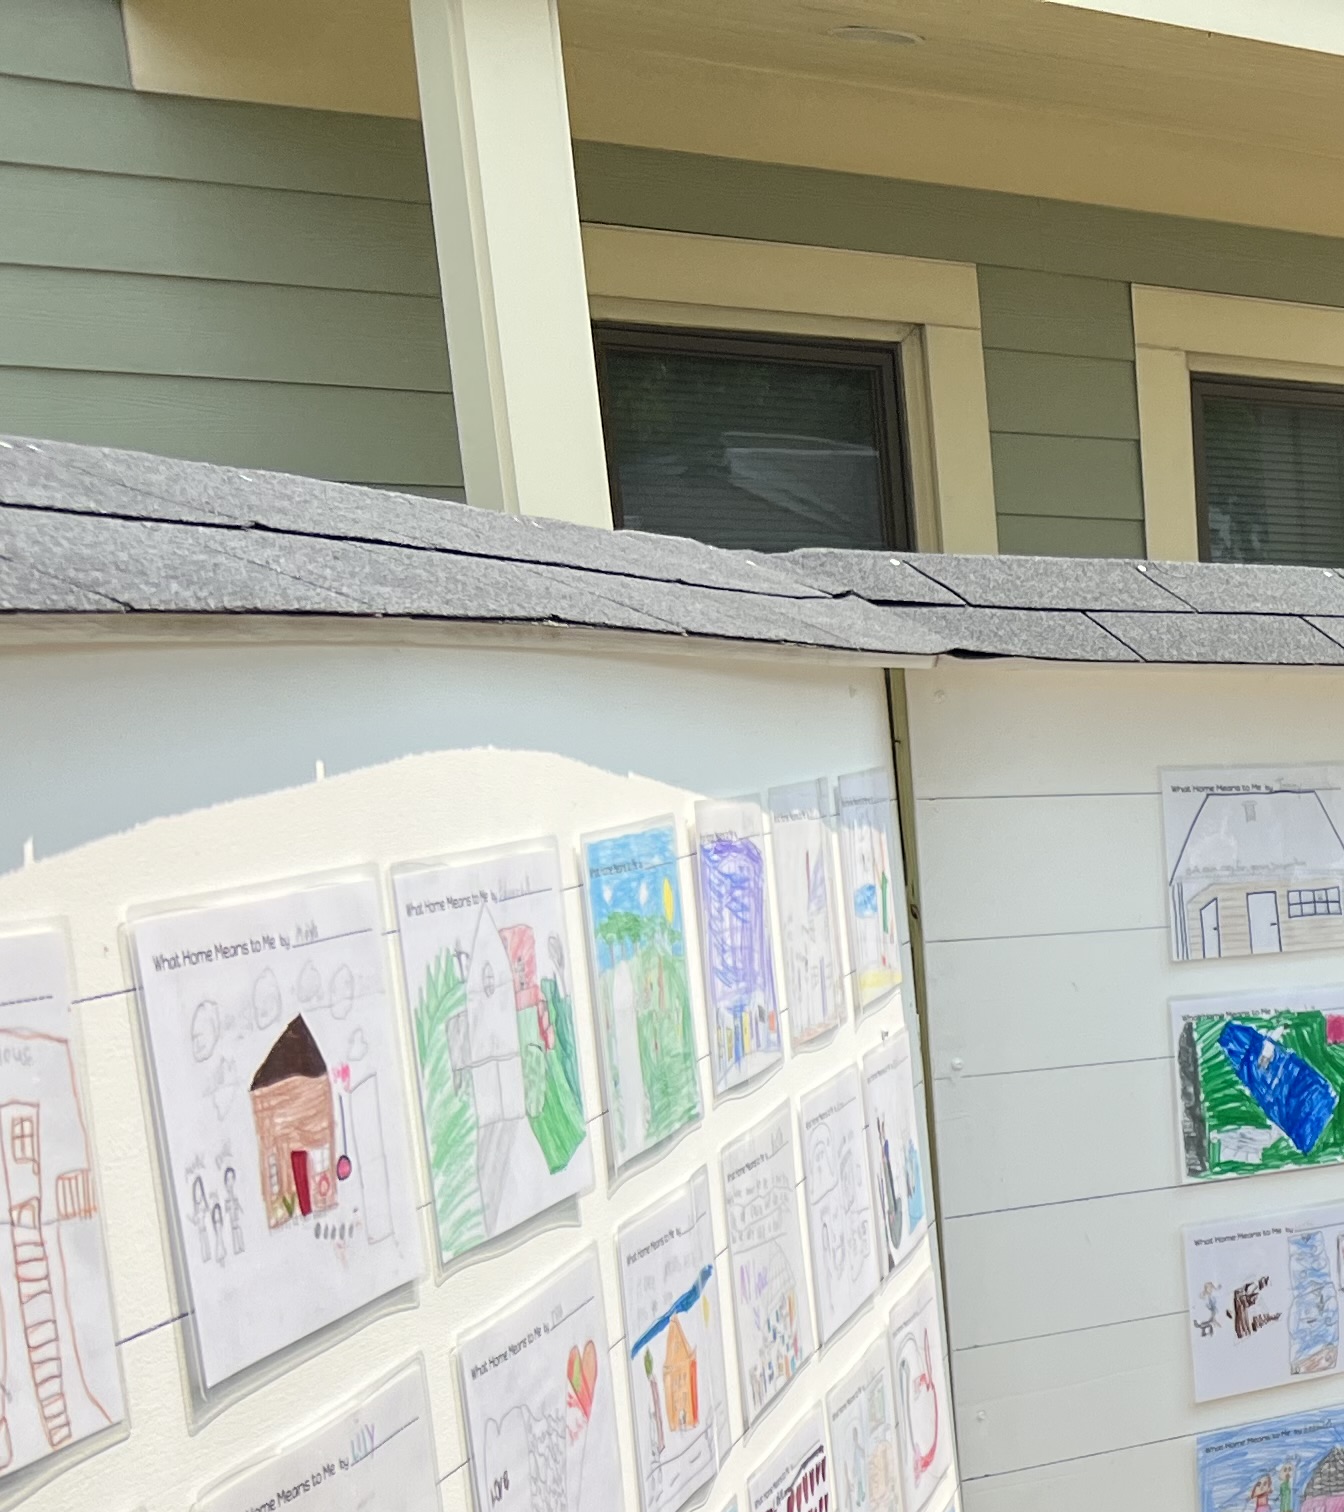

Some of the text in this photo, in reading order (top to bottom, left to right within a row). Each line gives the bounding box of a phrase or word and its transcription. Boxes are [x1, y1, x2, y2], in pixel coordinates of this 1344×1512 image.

[1171, 785, 1190, 793] What
[1192, 785, 1210, 793] Home
[1216, 784, 1240, 792] Means
[1251, 783, 1261, 791] Me
[152, 933, 291, 972] What Home Means to Me by
[1194, 1238, 1213, 1247] What
[1214, 1235, 1236, 1243] Home
[1237, 1231, 1262, 1240] Means
[1272, 1227, 1282, 1235] Me
[470, 1361, 488, 1381] What
[488, 1350, 509, 1370] Home
[508, 1336, 528, 1357] Means
[534, 1326, 542, 1340] Me
[276, 1478, 311, 1508] Means
[311, 1471, 322, 1488] to
[322, 1463, 336, 1480] Me
[339, 1456, 350, 1471] by
